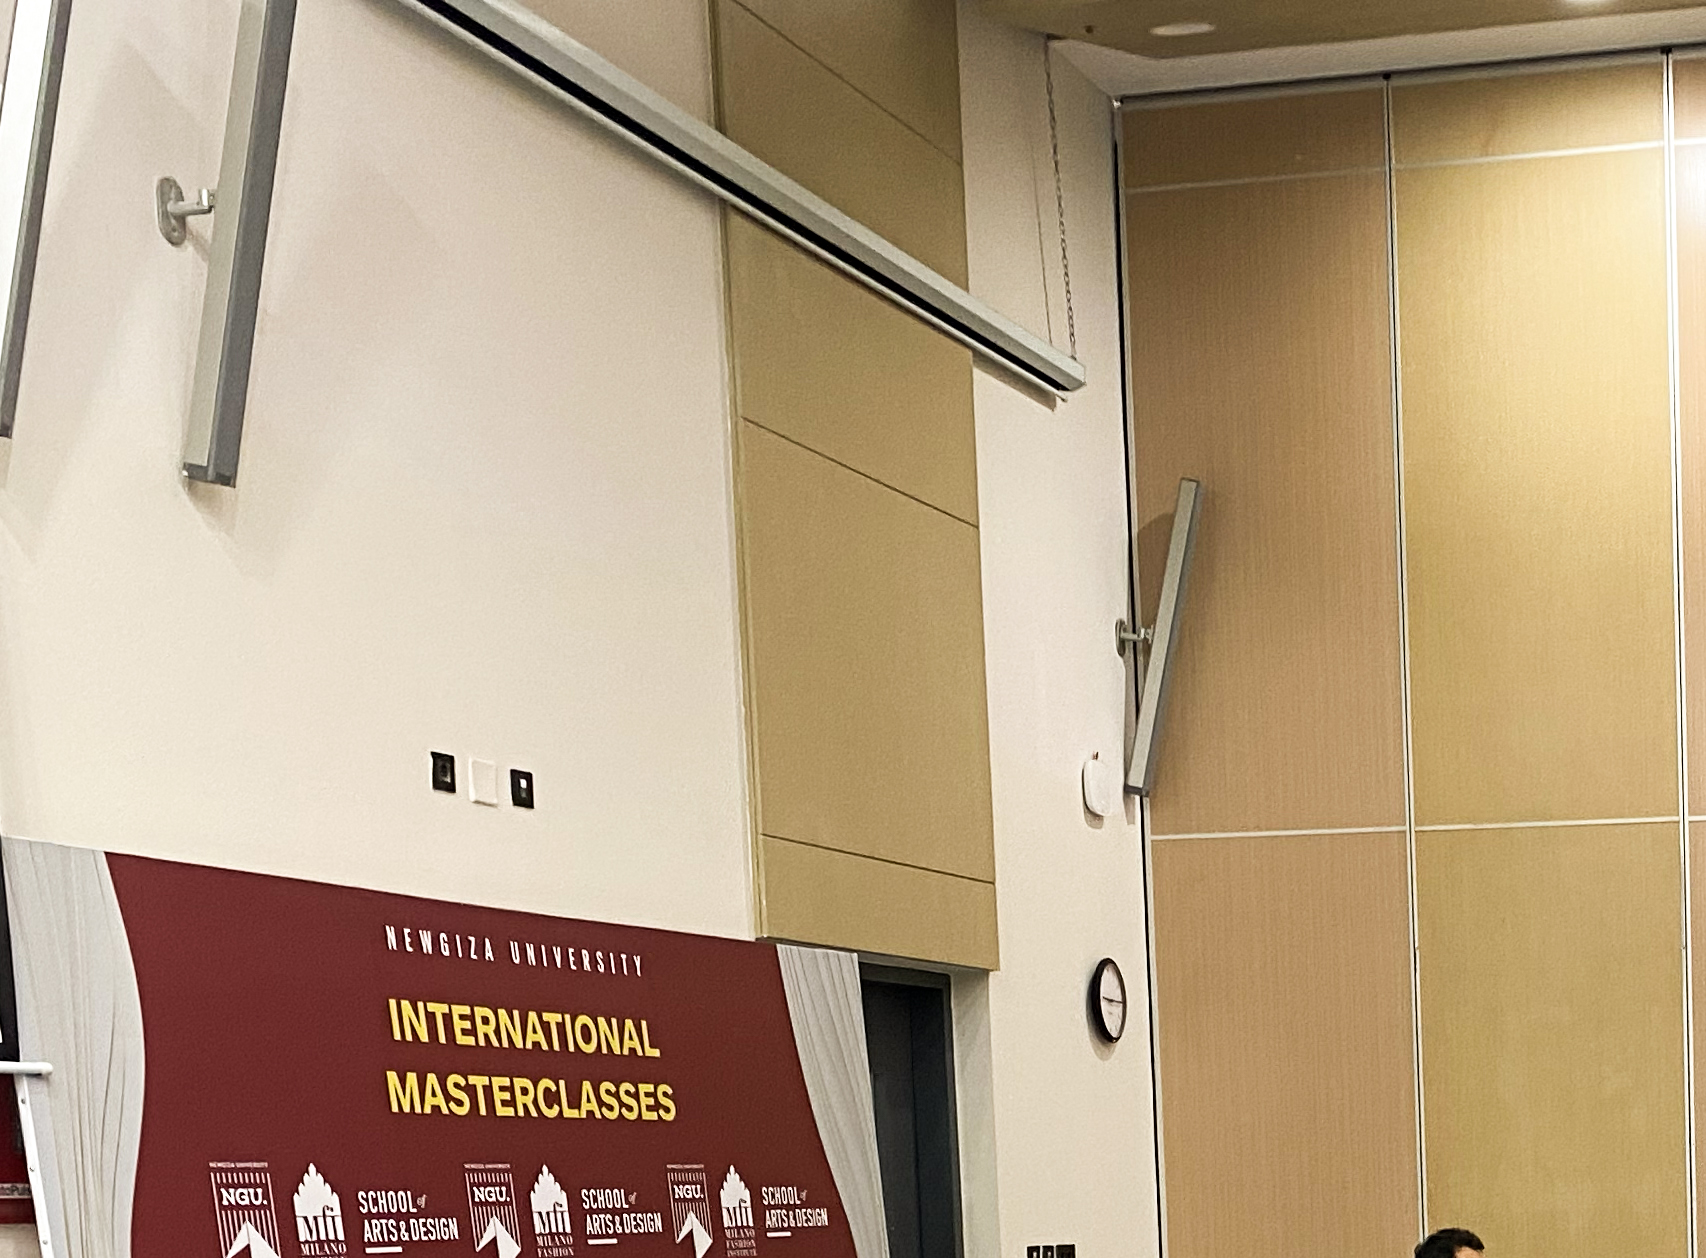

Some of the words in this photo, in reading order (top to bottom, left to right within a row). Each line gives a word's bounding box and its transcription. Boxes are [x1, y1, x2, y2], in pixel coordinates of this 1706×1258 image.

[385, 924, 495, 962] NEWGIZA
[509, 940, 642, 977] UNIVERSITY
[388, 998, 661, 1058] INTERNATIONAL
[386, 1070, 677, 1122] MASTERCLASSES
[220, 1188, 267, 1205] NGU.
[473, 1186, 510, 1202] NGU.
[581, 1189, 629, 1209] SCHOOL
[674, 1184, 704, 1199] NGU.
[761, 1187, 800, 1205] SCHOOL
[358, 1191, 417, 1213] SCHOOL
[586, 1214, 614, 1235] ARTS
[614, 1216, 622, 1233] &
[623, 1213, 662, 1233] DESIGN
[766, 1209, 788, 1229] ARTS
[788, 1211, 795, 1227] &
[795, 1208, 828, 1227] DESIGN
[364, 1219, 397, 1242] ARTS
[400, 1221, 410, 1240] &
[411, 1217, 459, 1241] DESIGN
[300, 1243, 346, 1256] MILANO
[536, 1235, 573, 1246] MILANO
[537, 1247, 574, 1258] FASHION
